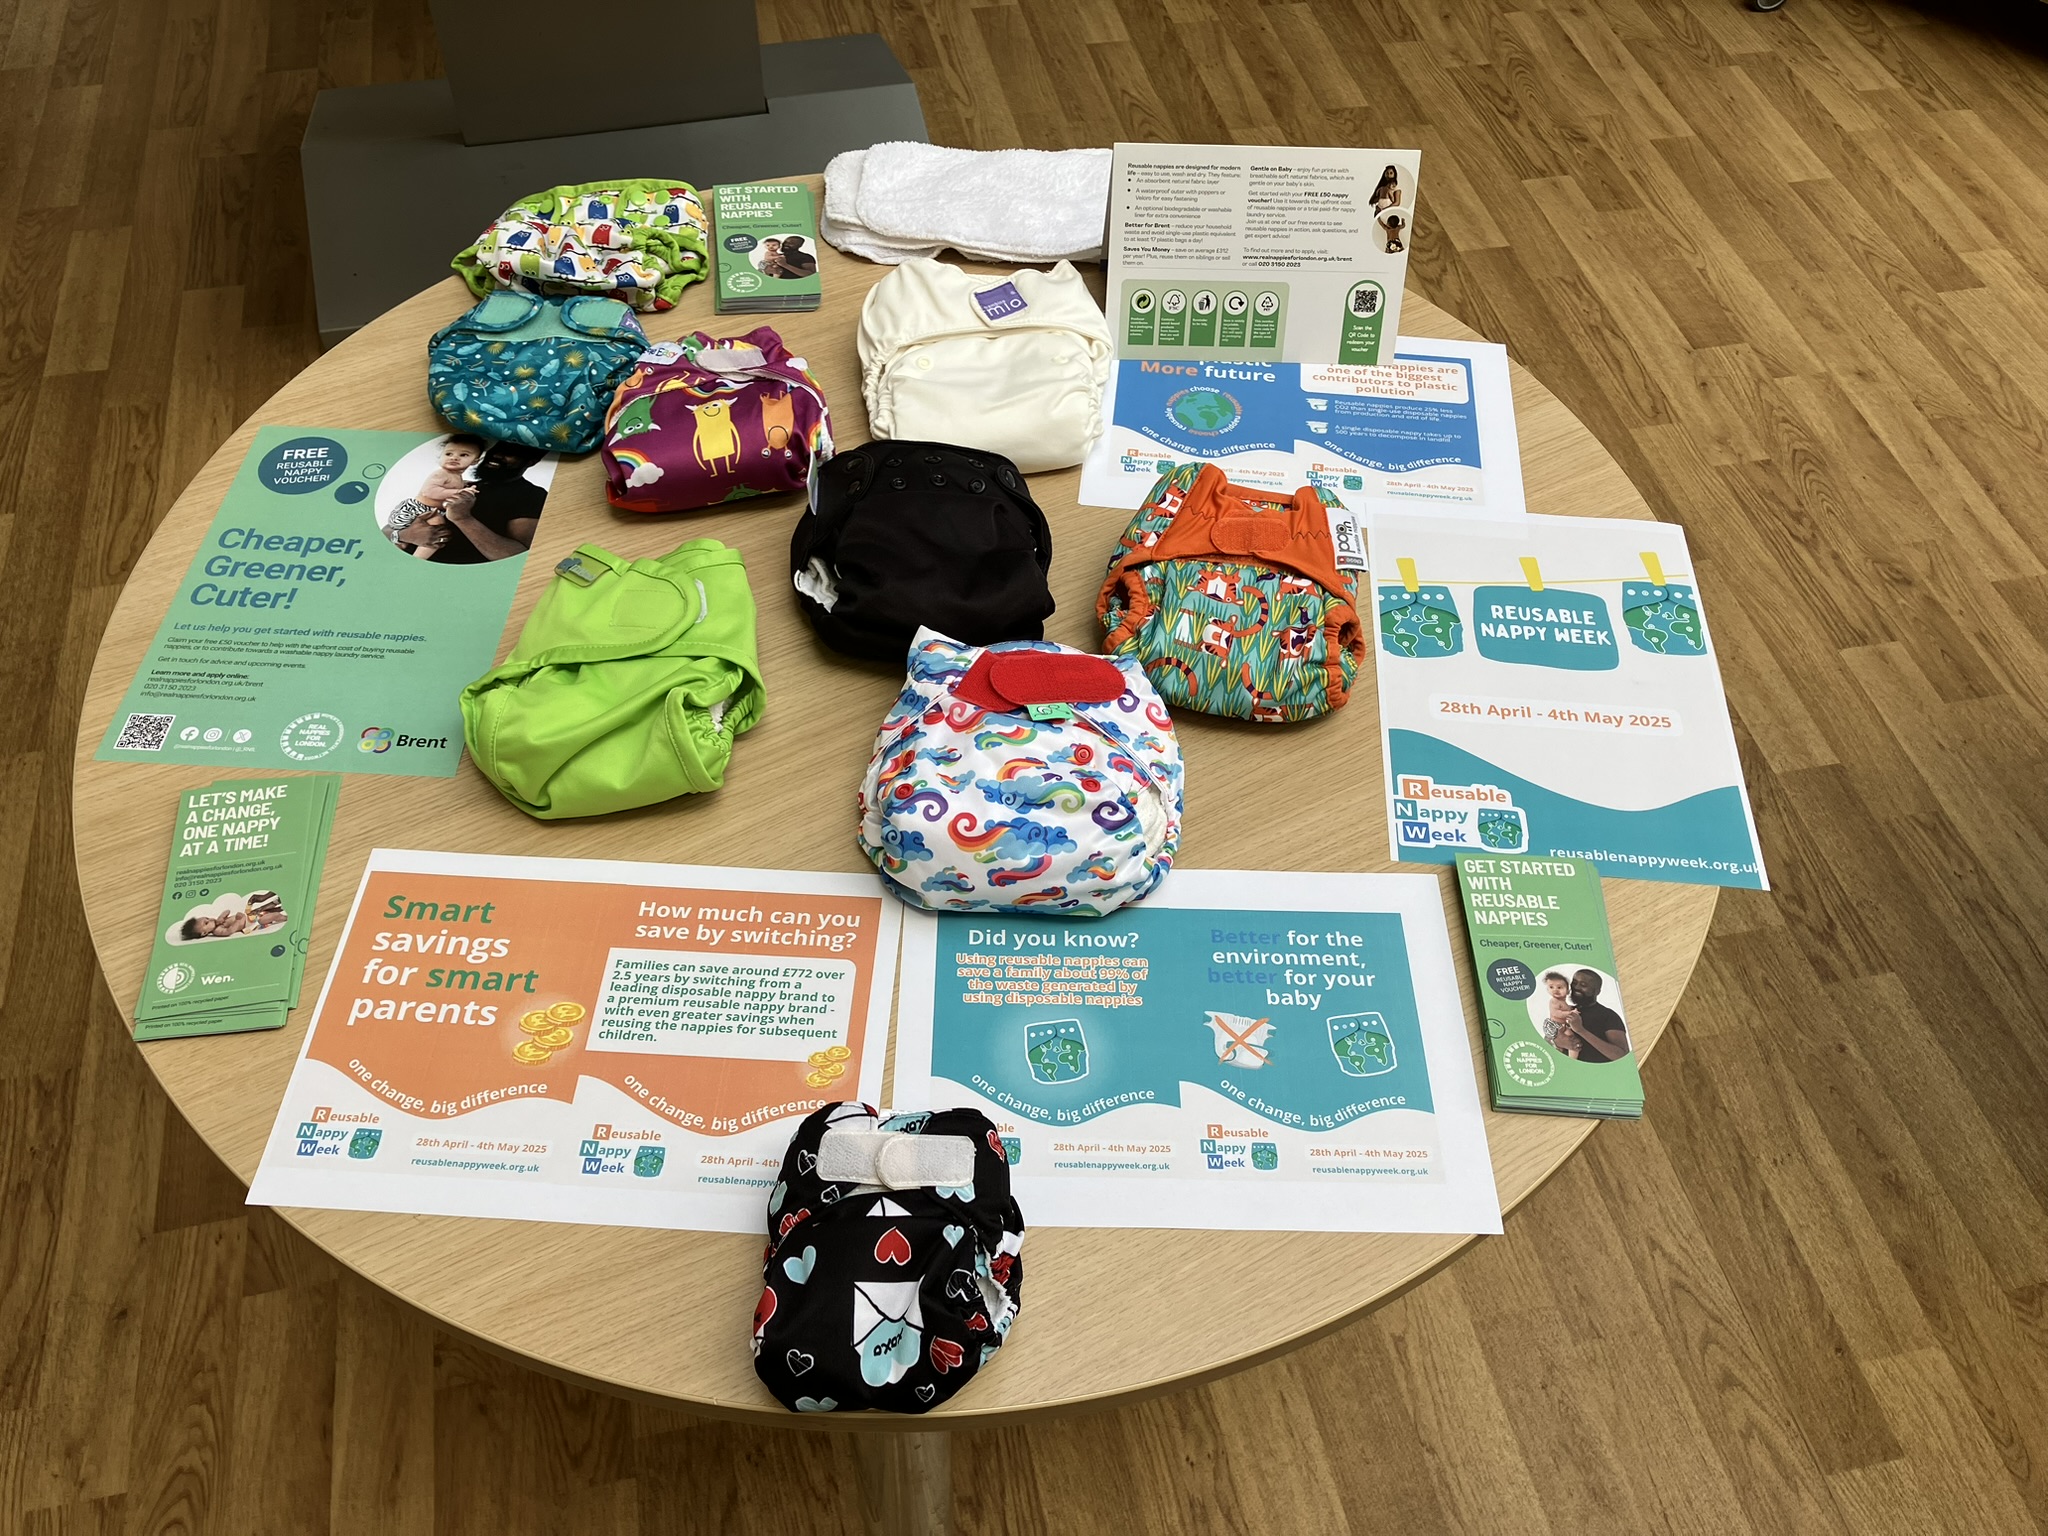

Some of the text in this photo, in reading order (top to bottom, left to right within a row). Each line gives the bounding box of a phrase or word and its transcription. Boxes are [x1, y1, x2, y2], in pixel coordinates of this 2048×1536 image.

[719, 187, 742, 195] GET
[720, 202, 783, 211] REUSABLE
[721, 210, 773, 219] NAPPIES
[1141, 361, 1198, 376] More
[1205, 366, 1276, 382] future
[1327, 366, 1442, 382] one of the biggest
[1312, 373, 1457, 392] contributors to plastic
[1356, 385, 1414, 397] pollution
[282, 447, 329, 460] FREE
[276, 459, 333, 470] REUSABLE
[284, 467, 322, 476] NAPPY
[274, 474, 329, 485] VOUCHER!
[218, 528, 364, 560] Cheaper,
[204, 555, 346, 588] Greener,
[190, 583, 298, 610] Cuter!
[1490, 604, 1596, 626] REUSABLE
[207, 623, 230, 633] help
[336, 631, 381, 639] reusable
[383, 633, 426, 642] nappies.
[1480, 622, 1612, 646] NAPPY WEEK
[1440, 701, 1481, 714] 28th
[1487, 704, 1531, 719] April
[1547, 709, 1578, 721] 4th
[1584, 711, 1623, 727] May
[1628, 714, 1671, 727] 2025
[396, 734, 447, 749] Brent
[188, 785, 288, 808] LET'S MAKE
[1403, 778, 1507, 803] Reusable
[185, 802, 276, 824] A CHANGE,
[1394, 800, 1469, 824] Nappy
[183, 816, 281, 840] ONE NAPPY
[1403, 821, 1468, 843] Week
[180, 834, 268, 857] AT A TIME!
[1464, 860, 1576, 877] GET STARTED
[1466, 876, 1512, 890] WITH
[383, 895, 496, 924] Smart
[1470, 893, 1560, 910] REUSABLE
[638, 901, 860, 929] How much can you
[1474, 910, 1548, 927] NAPPIES
[371, 929, 510, 964] savings
[635, 924, 856, 951] save by switching?
[968, 929, 1139, 950] Did you know?
[1211, 929, 1363, 947] Better for the
[1479, 939, 1593, 951] Cheaper, Greener, Cuter!
[614, 959, 845, 979] Families can save around £772 over
[956, 953, 1148, 968] Using reusable nappies can
[1212, 949, 1366, 969] environment,
[201, 973, 234, 986] Wen.
[362, 958, 539, 993] for smart
[611, 970, 802, 991] 2.5 years by switching from a
[957, 966, 1147, 980] save a family about 99% of
[1207, 968, 1375, 990] better for your
[609, 981, 835, 1002] leading disposable nappy brand to
[968, 979, 1137, 995] the waste generated by
[617, 994, 682, 1007] premium
[681, 996, 740, 1009] reusable
[743, 998, 785, 1013] nappy
[788, 1002, 827, 1013] brand
[963, 992, 1143, 1008] using disposable nappies
[1266, 989, 1321, 1010] baby
[347, 998, 498, 1026] parents
[604, 1005, 814, 1025] with even greater savings when
[598, 1029, 657, 1042] children.
[601, 1018, 837, 1039] reusing the nappies for subsequent
[415, 1137, 440, 1146] 28th
[441, 1139, 468, 1150] April
[476, 1141, 494, 1150] 4th
[496, 1142, 520, 1153] May
[521, 1144, 546, 1153] 2025
[411, 1157, 539, 1173] reusablenappyweek.org.uk
